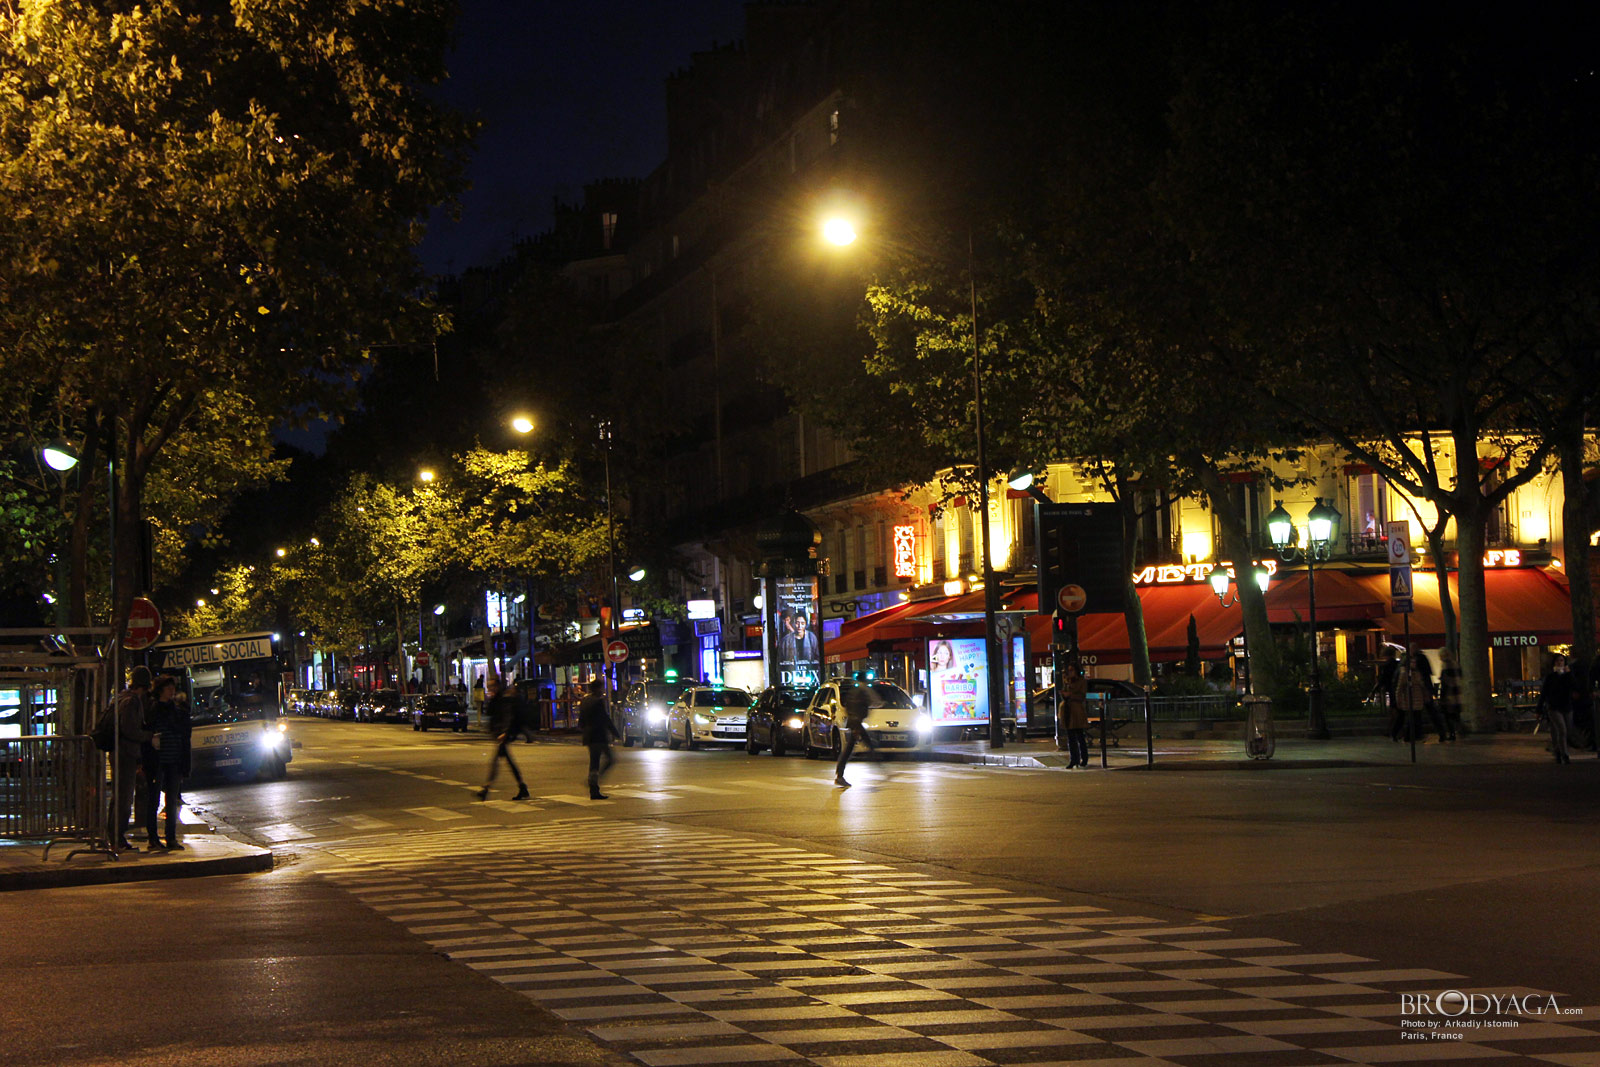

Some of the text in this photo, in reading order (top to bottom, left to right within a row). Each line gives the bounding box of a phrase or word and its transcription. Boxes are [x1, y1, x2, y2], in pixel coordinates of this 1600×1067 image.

[1493, 635, 1538, 646] METRO
[167, 640, 265, 666] RECUEIL SOCIAL
[1039, 656, 1052, 666] LE
[945, 683, 973, 691] HARIBO
